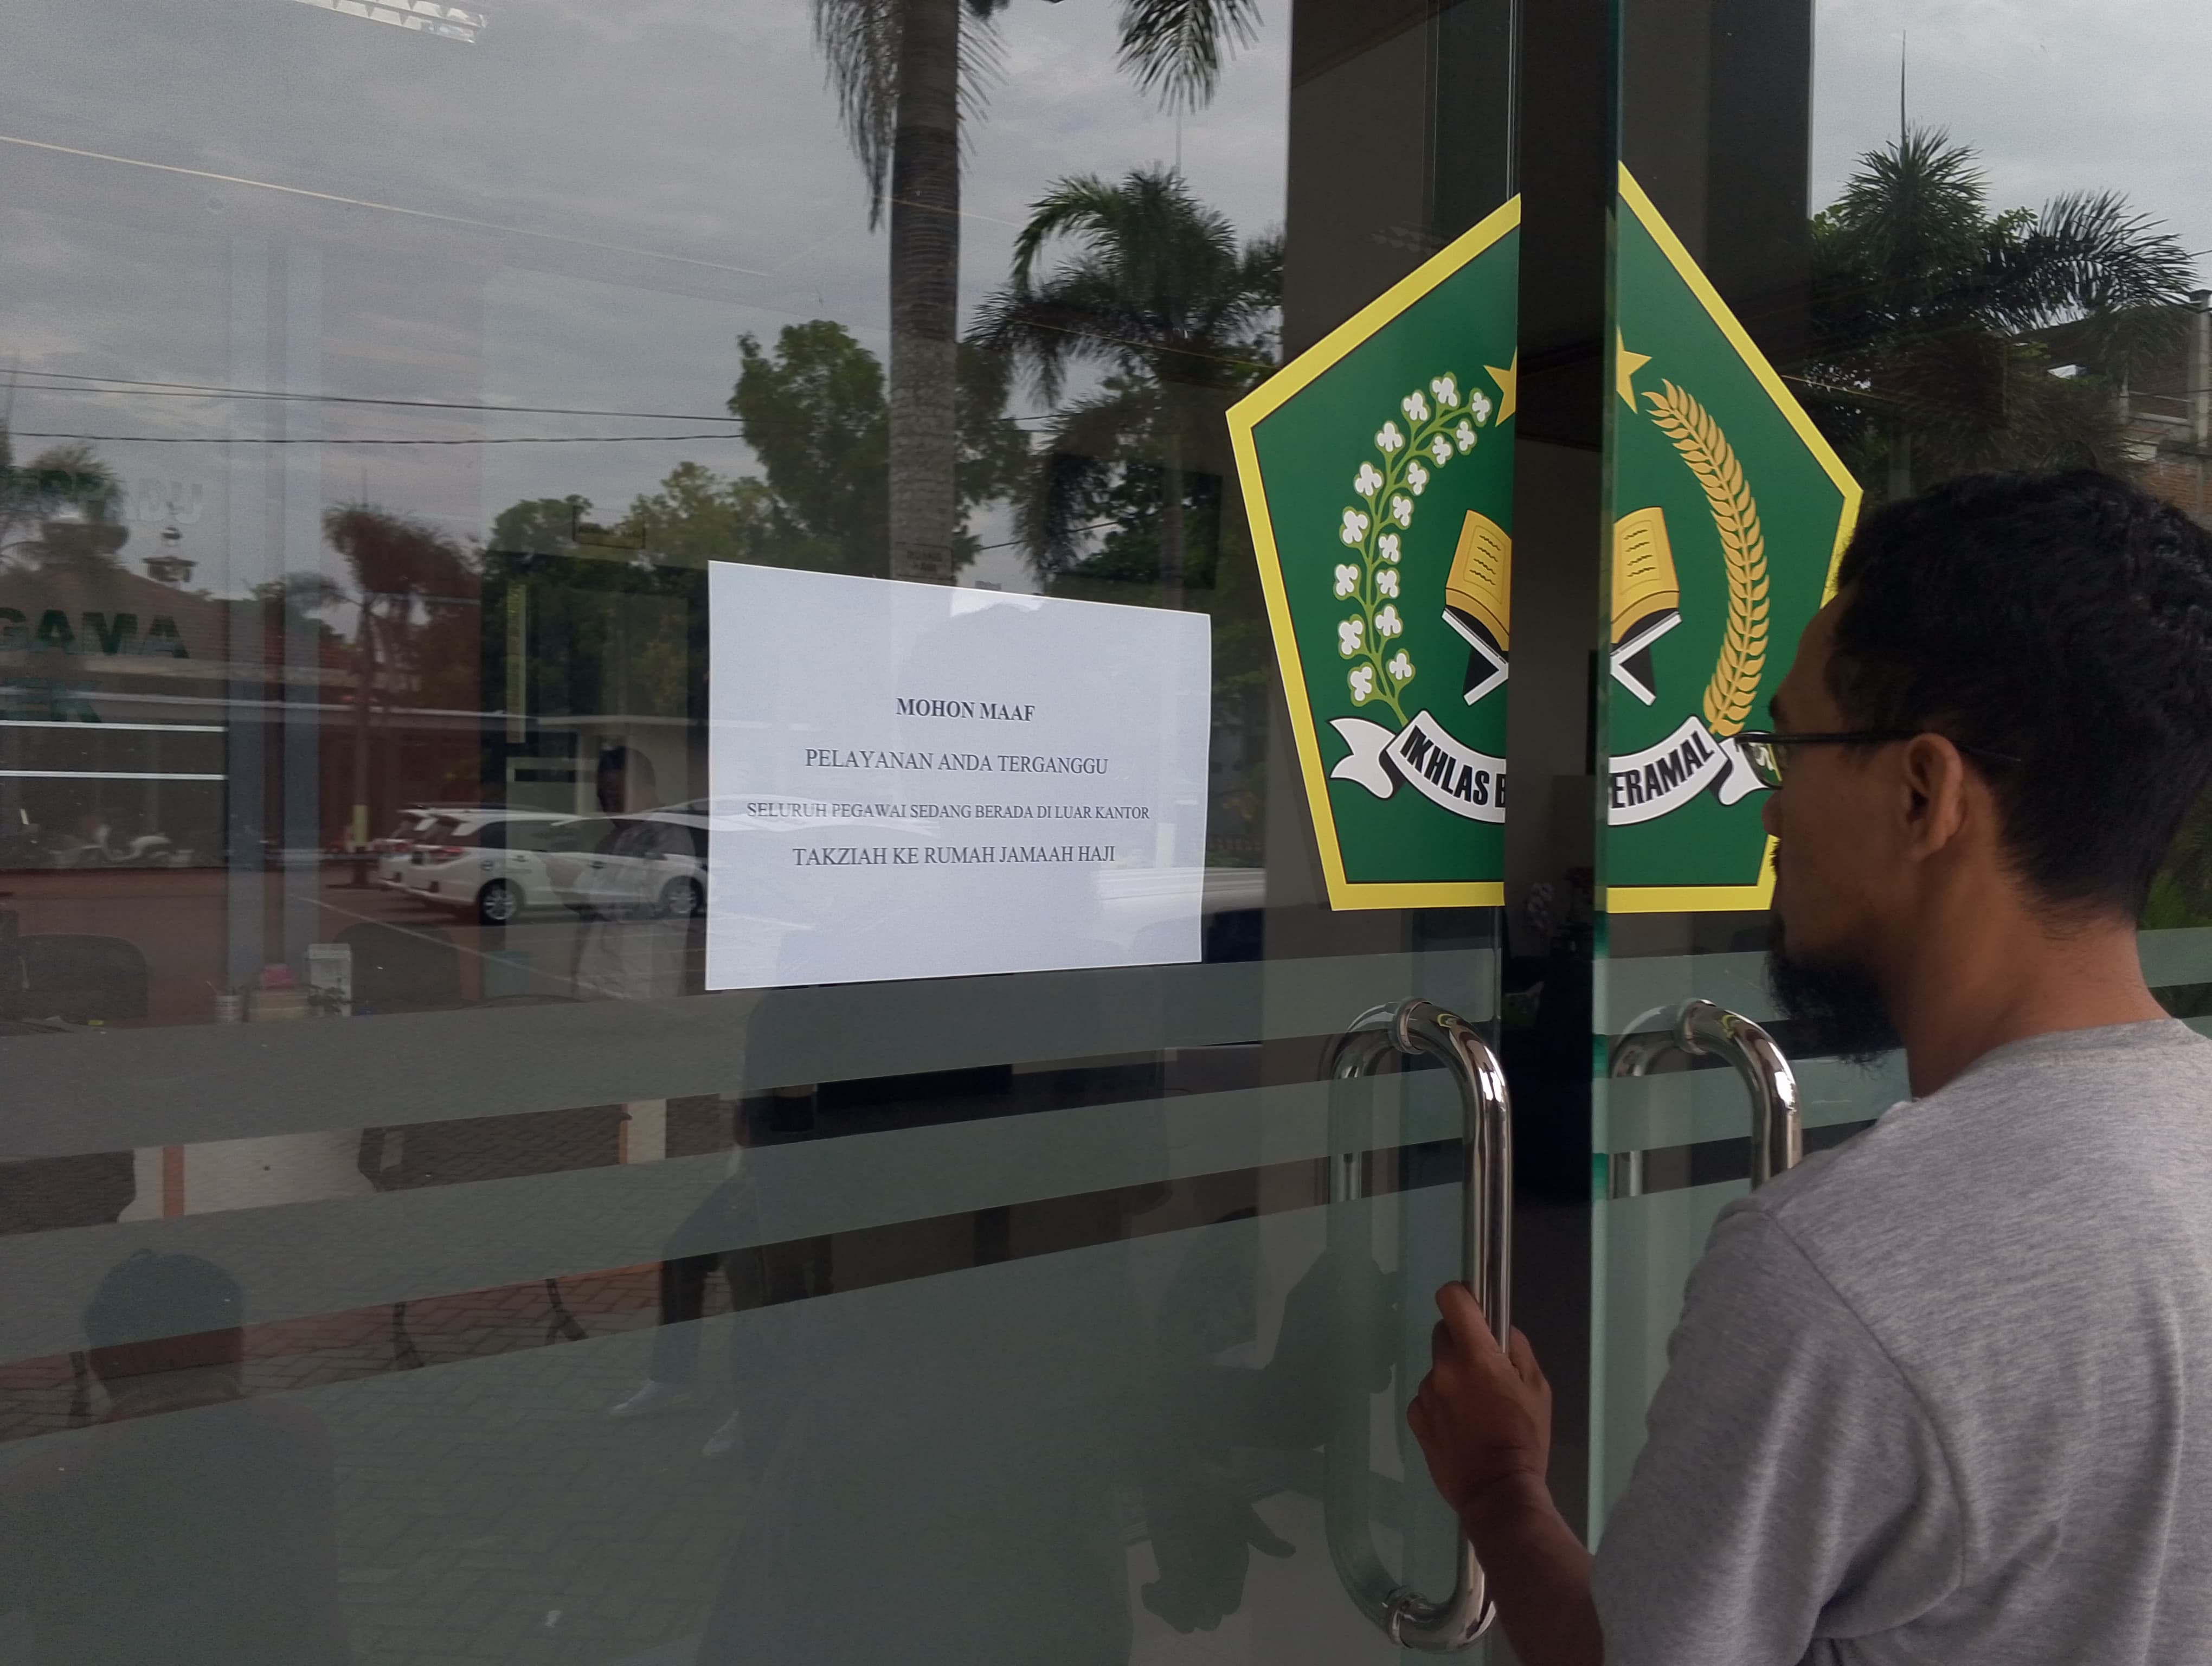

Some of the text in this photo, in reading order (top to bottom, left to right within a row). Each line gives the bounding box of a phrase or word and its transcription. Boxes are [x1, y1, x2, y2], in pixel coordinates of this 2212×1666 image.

[895, 697, 1036, 721] MOHON MAAF
[805, 748, 1109, 774] PELAYANAN ANDA TERGANGGU
[1400, 725, 1489, 805] IKHLAS
[747, 802, 1150, 819] SELURUH PEGAWAI SEDANG BERADA DI LUAR KANTOR
[792, 845, 1115, 866] TAKZIAH KE RUMAH JAMAAH HAJI
